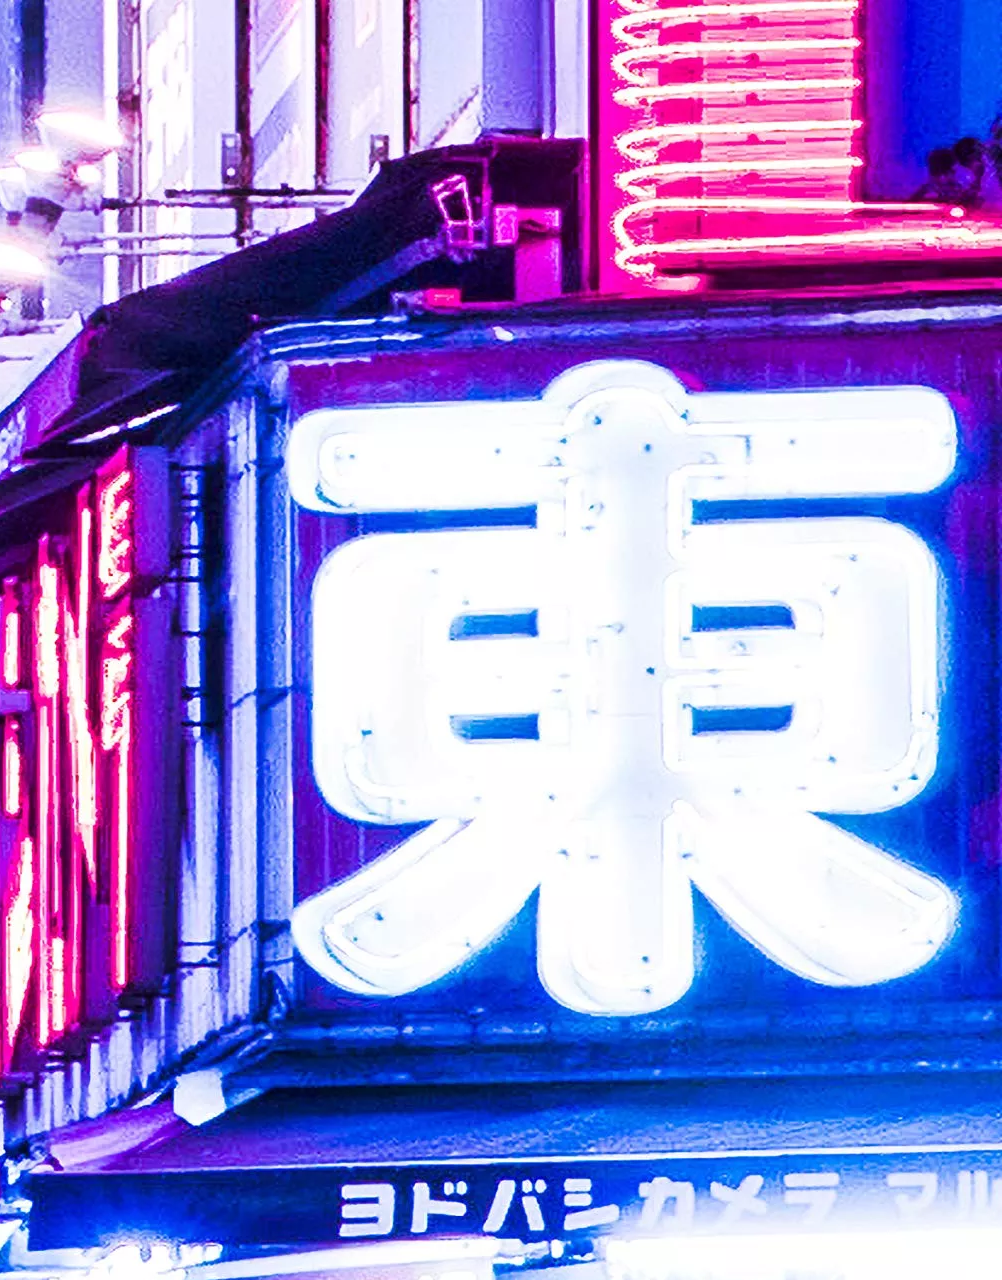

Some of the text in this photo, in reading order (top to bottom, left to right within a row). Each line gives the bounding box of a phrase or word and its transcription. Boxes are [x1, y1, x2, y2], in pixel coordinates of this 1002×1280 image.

[288, 359, 957, 1015] 東
[338, 1172, 840, 1237] ヨドバシカメラ
